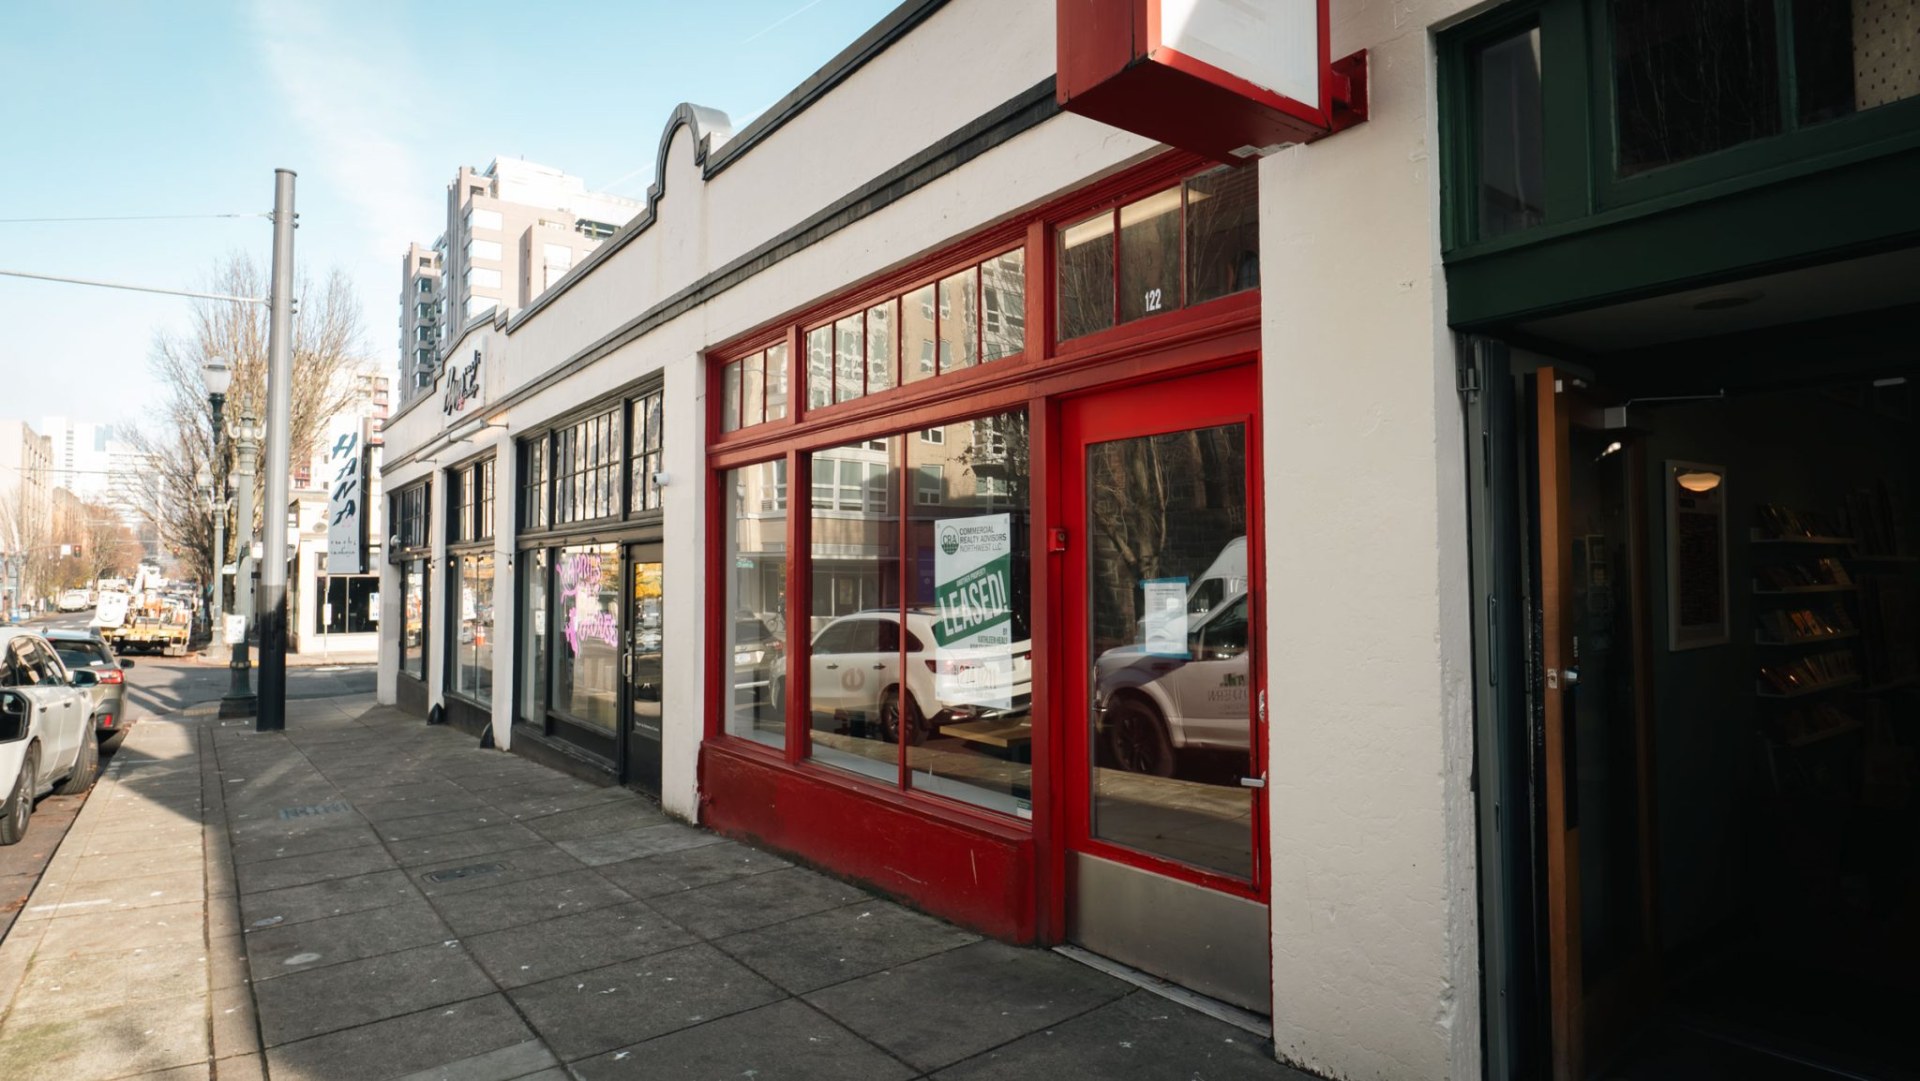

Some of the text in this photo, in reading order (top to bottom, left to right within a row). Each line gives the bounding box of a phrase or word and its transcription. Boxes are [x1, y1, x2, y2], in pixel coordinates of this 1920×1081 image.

[1145, 288, 1162, 312] 122
[331, 432, 358, 526] HANA
[959, 525, 994, 536] COMMERCIAL
[943, 534, 957, 545] CRA
[960, 533, 1007, 544] REALTY ADVISORS
[960, 543, 991, 552] NORTHWEST
[939, 570, 1009, 637] LEASED!
